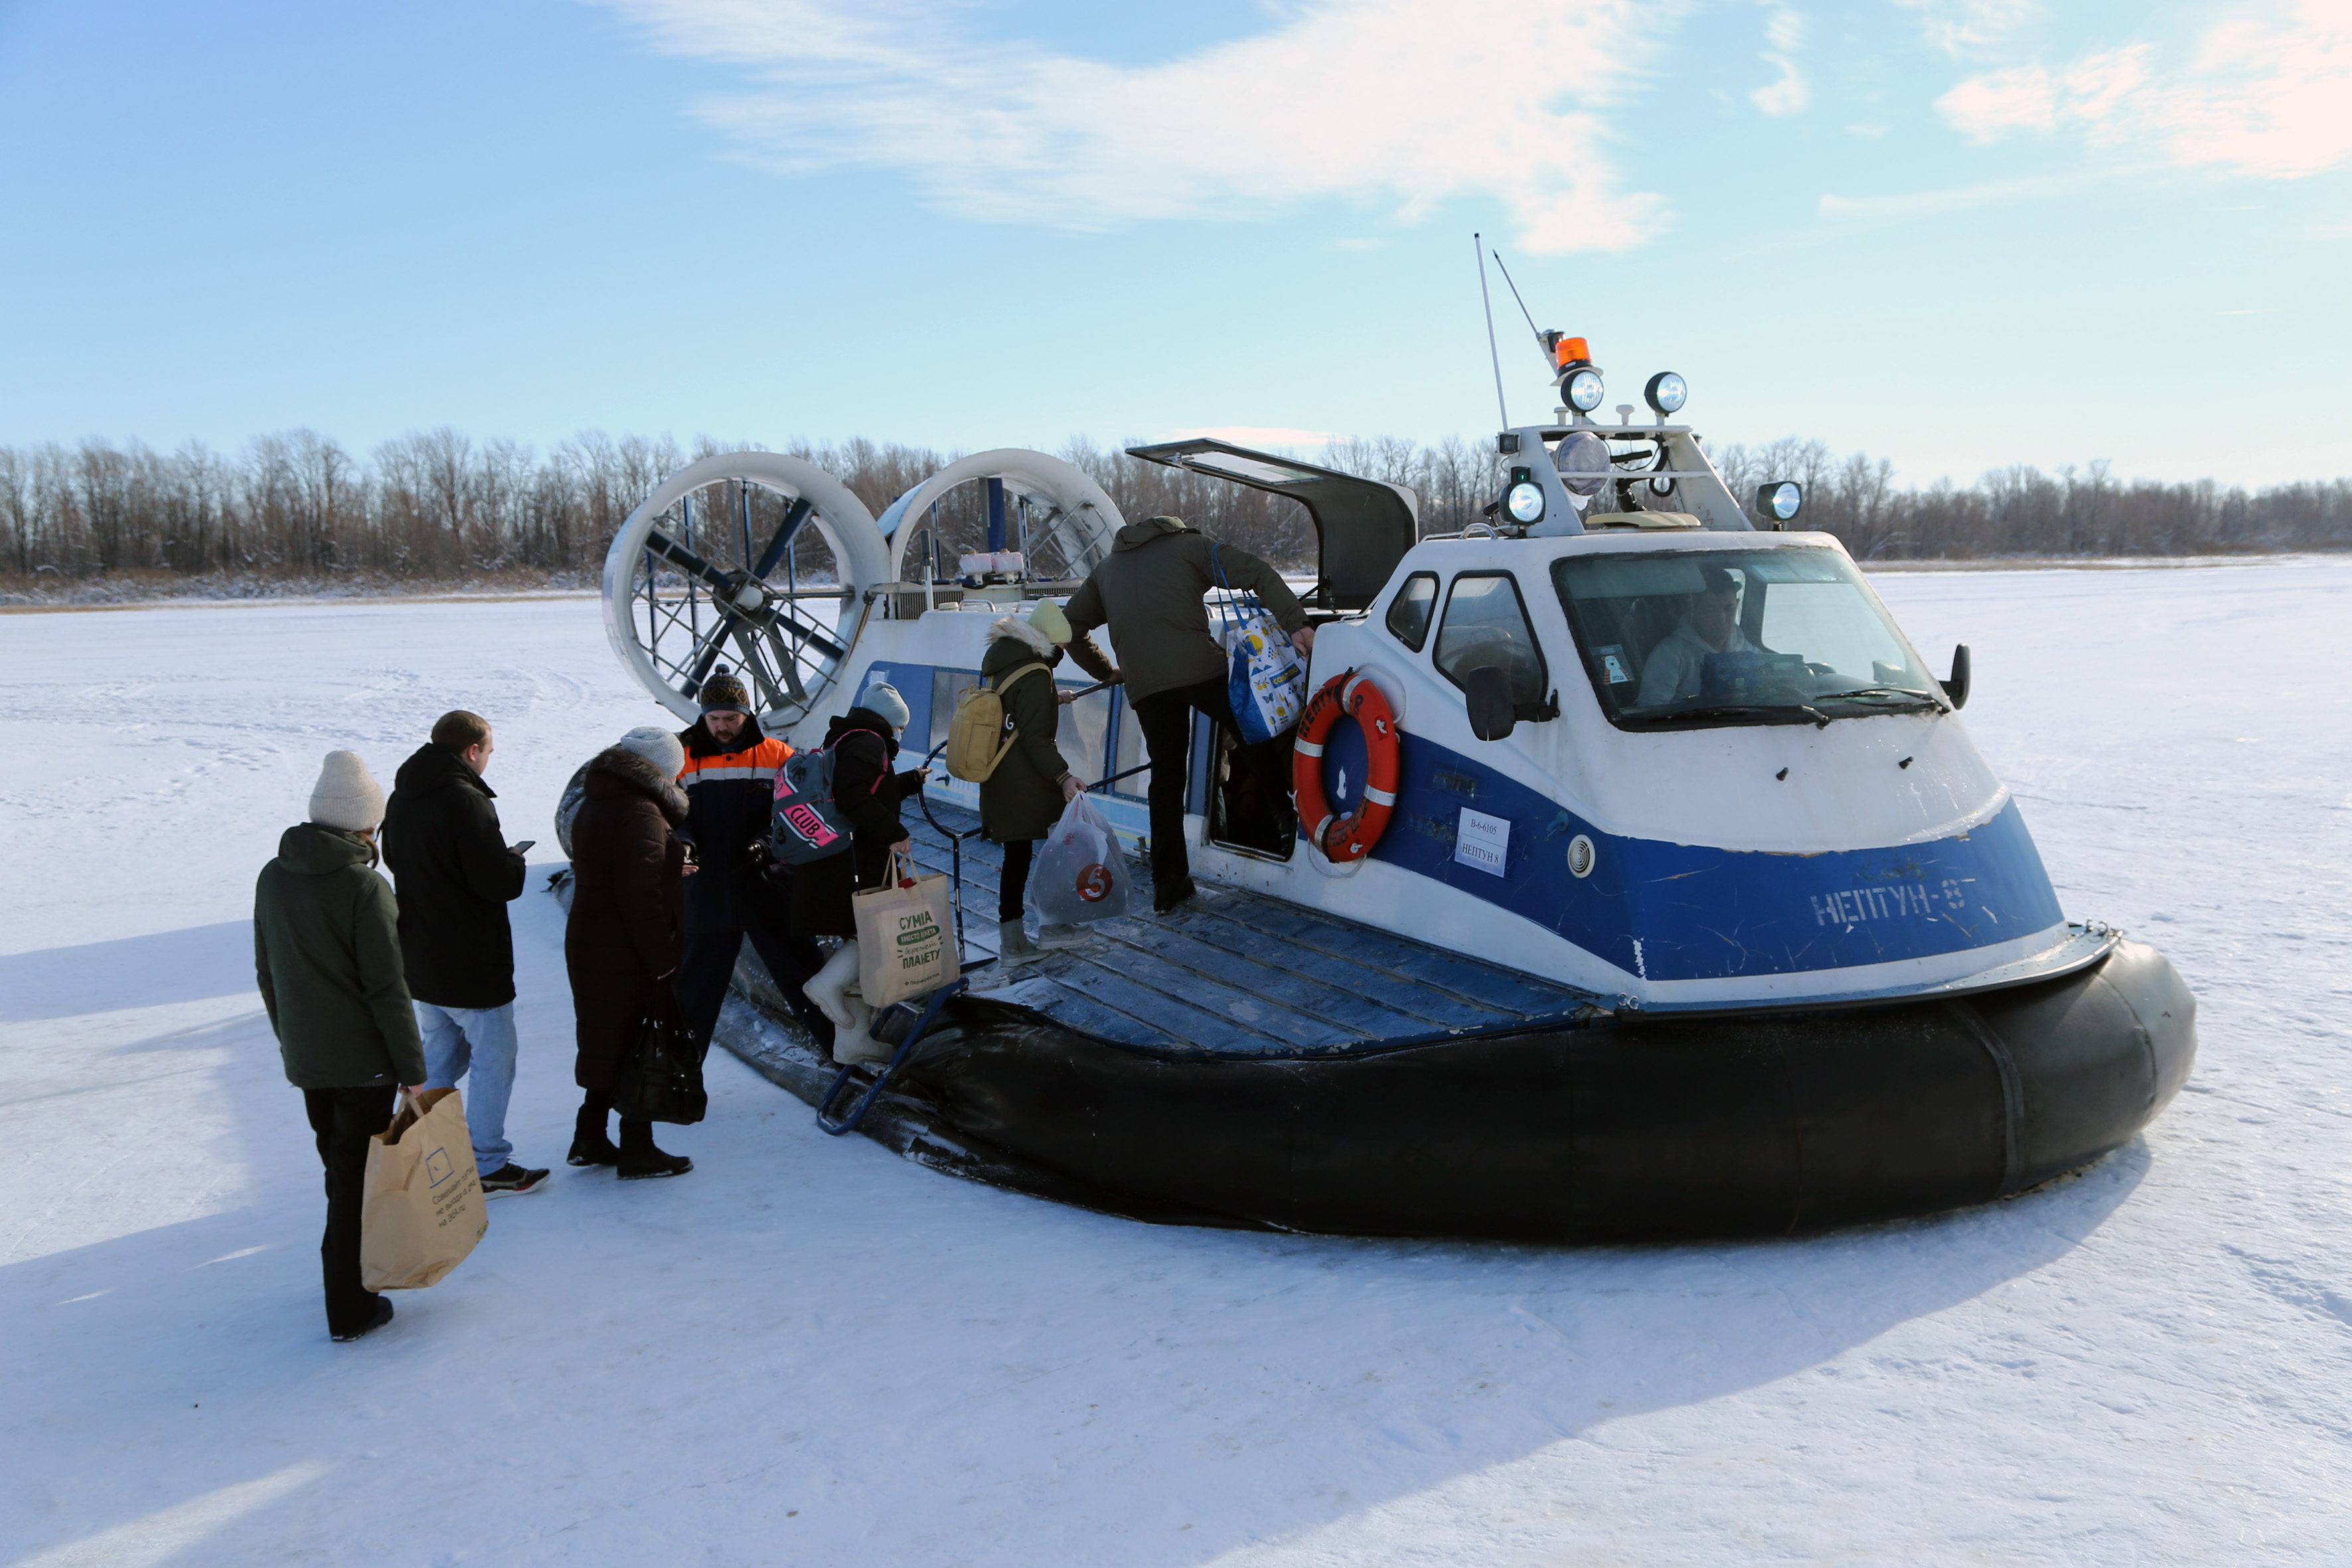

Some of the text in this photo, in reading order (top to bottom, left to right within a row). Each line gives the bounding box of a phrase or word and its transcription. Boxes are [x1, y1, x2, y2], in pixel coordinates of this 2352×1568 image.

[790, 807, 821, 836] CLUB
[1470, 819, 1498, 835] В-6-6105
[1462, 843, 1500, 864] НЕПТУН 8
[1810, 879, 1966, 926] НЕПТУН-8
